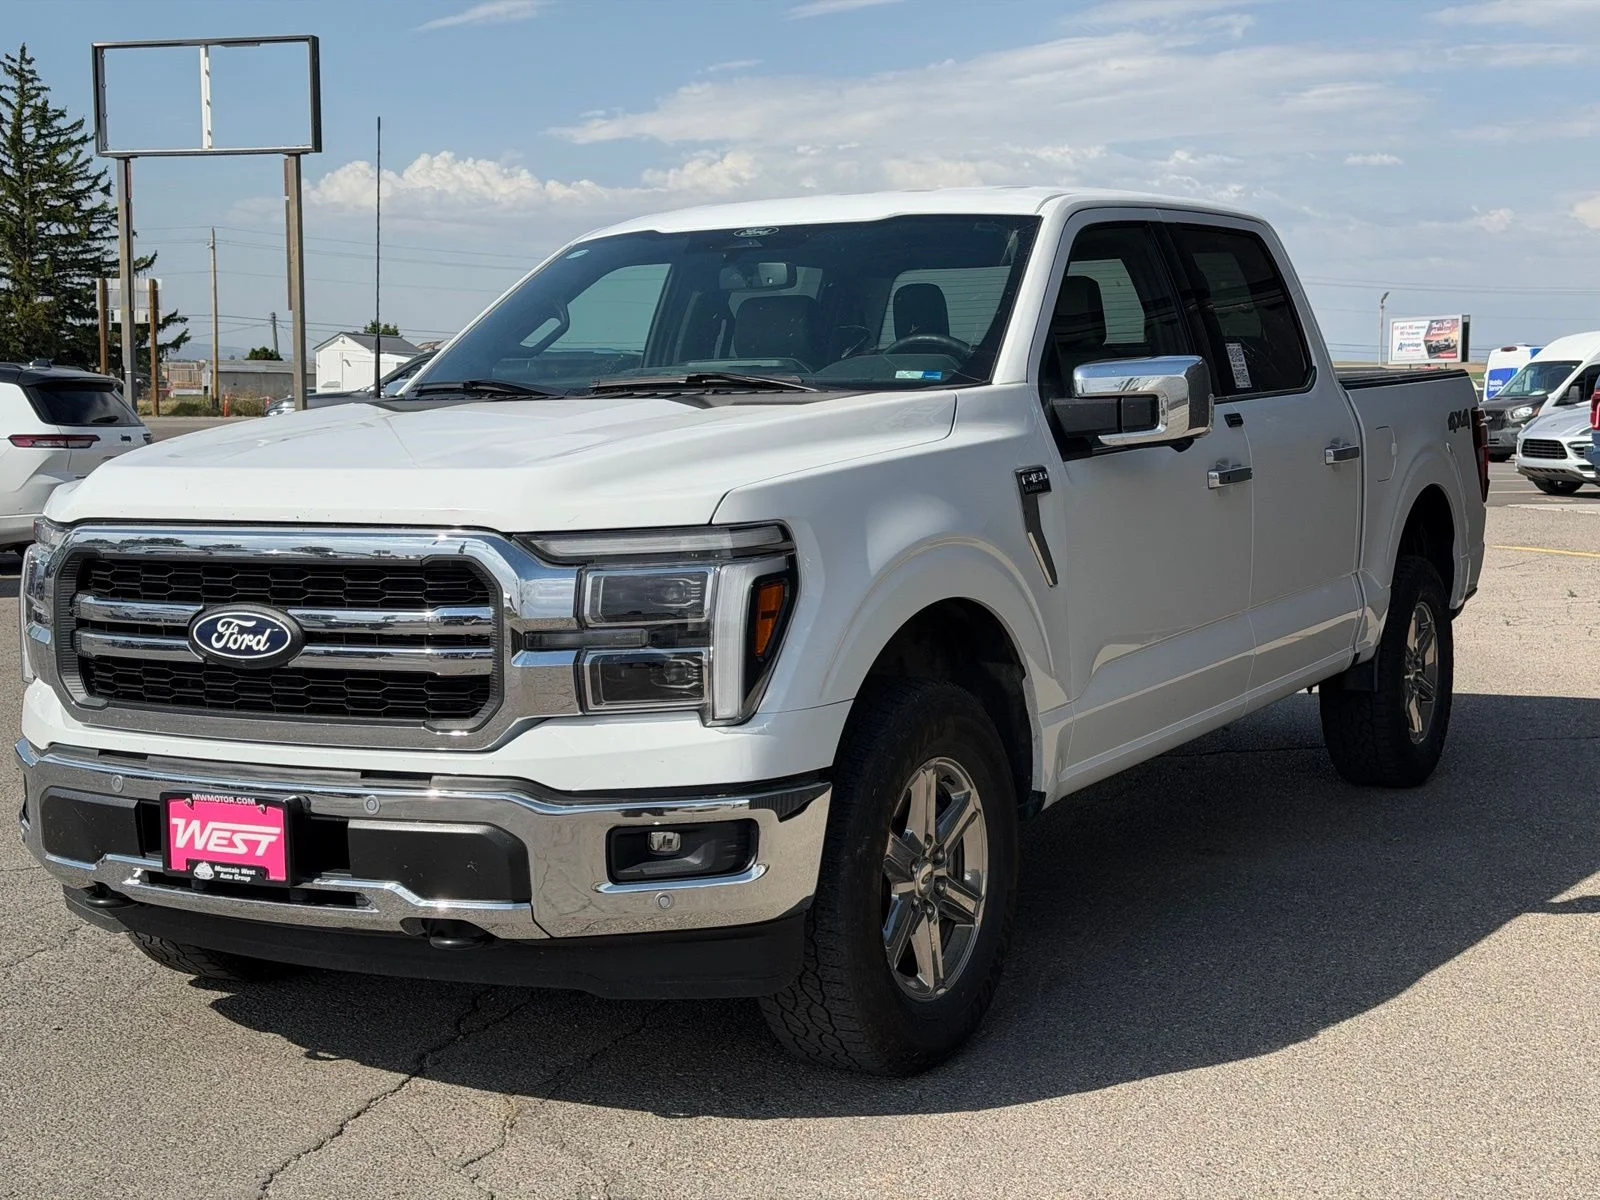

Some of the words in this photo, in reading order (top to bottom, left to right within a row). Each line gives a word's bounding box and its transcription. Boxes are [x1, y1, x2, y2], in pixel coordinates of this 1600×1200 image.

[211, 618, 278, 651] Ford
[191, 794, 256, 806] MWMOTOR.COM
[171, 817, 281, 857] WEST
[214, 865, 240, 875] Mountain
[240, 868, 256, 876] West
[219, 872, 233, 880] Auto
[233, 873, 251, 882] Group
